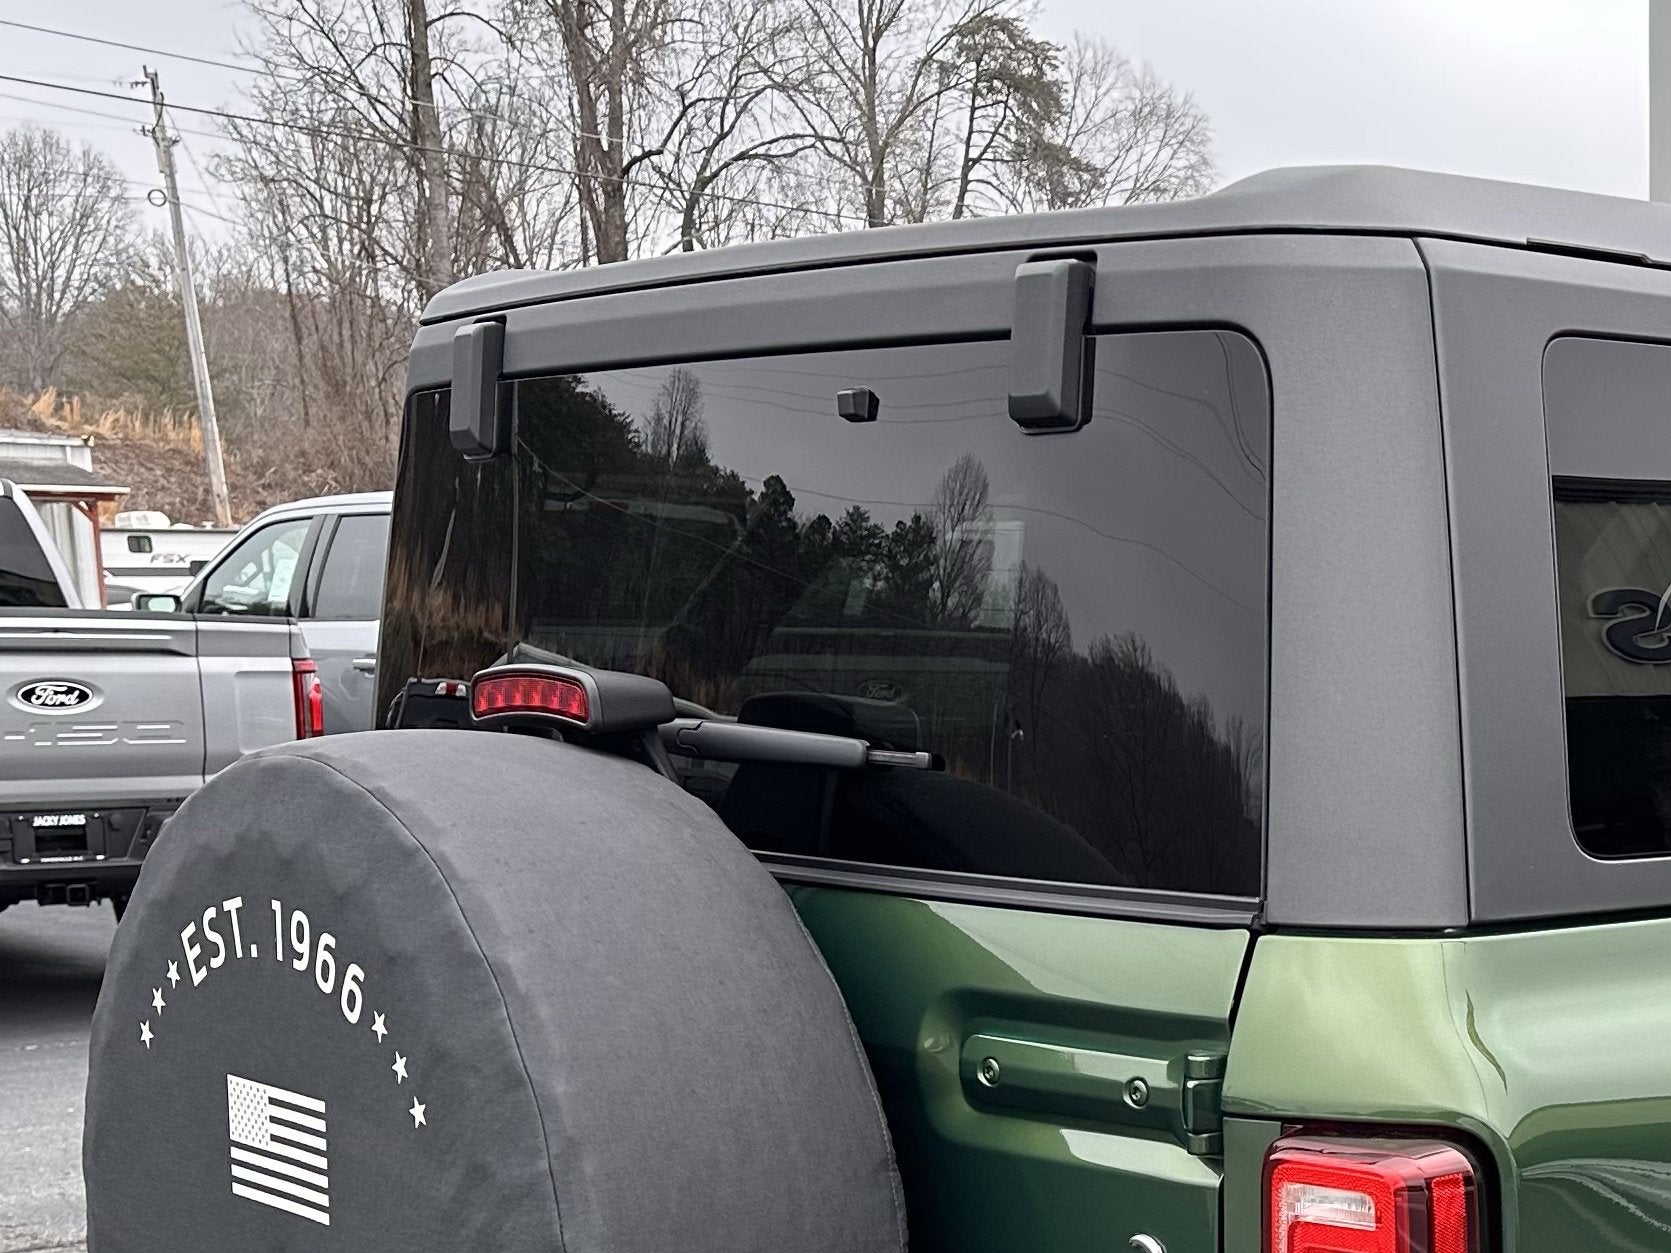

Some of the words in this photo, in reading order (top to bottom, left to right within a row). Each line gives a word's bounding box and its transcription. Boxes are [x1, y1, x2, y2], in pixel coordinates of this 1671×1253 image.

[30, 685, 80, 706] Ford
[32, 815, 59, 827] JACKY
[180, 896, 258, 987] EST.
[271, 899, 366, 1025] 1966
